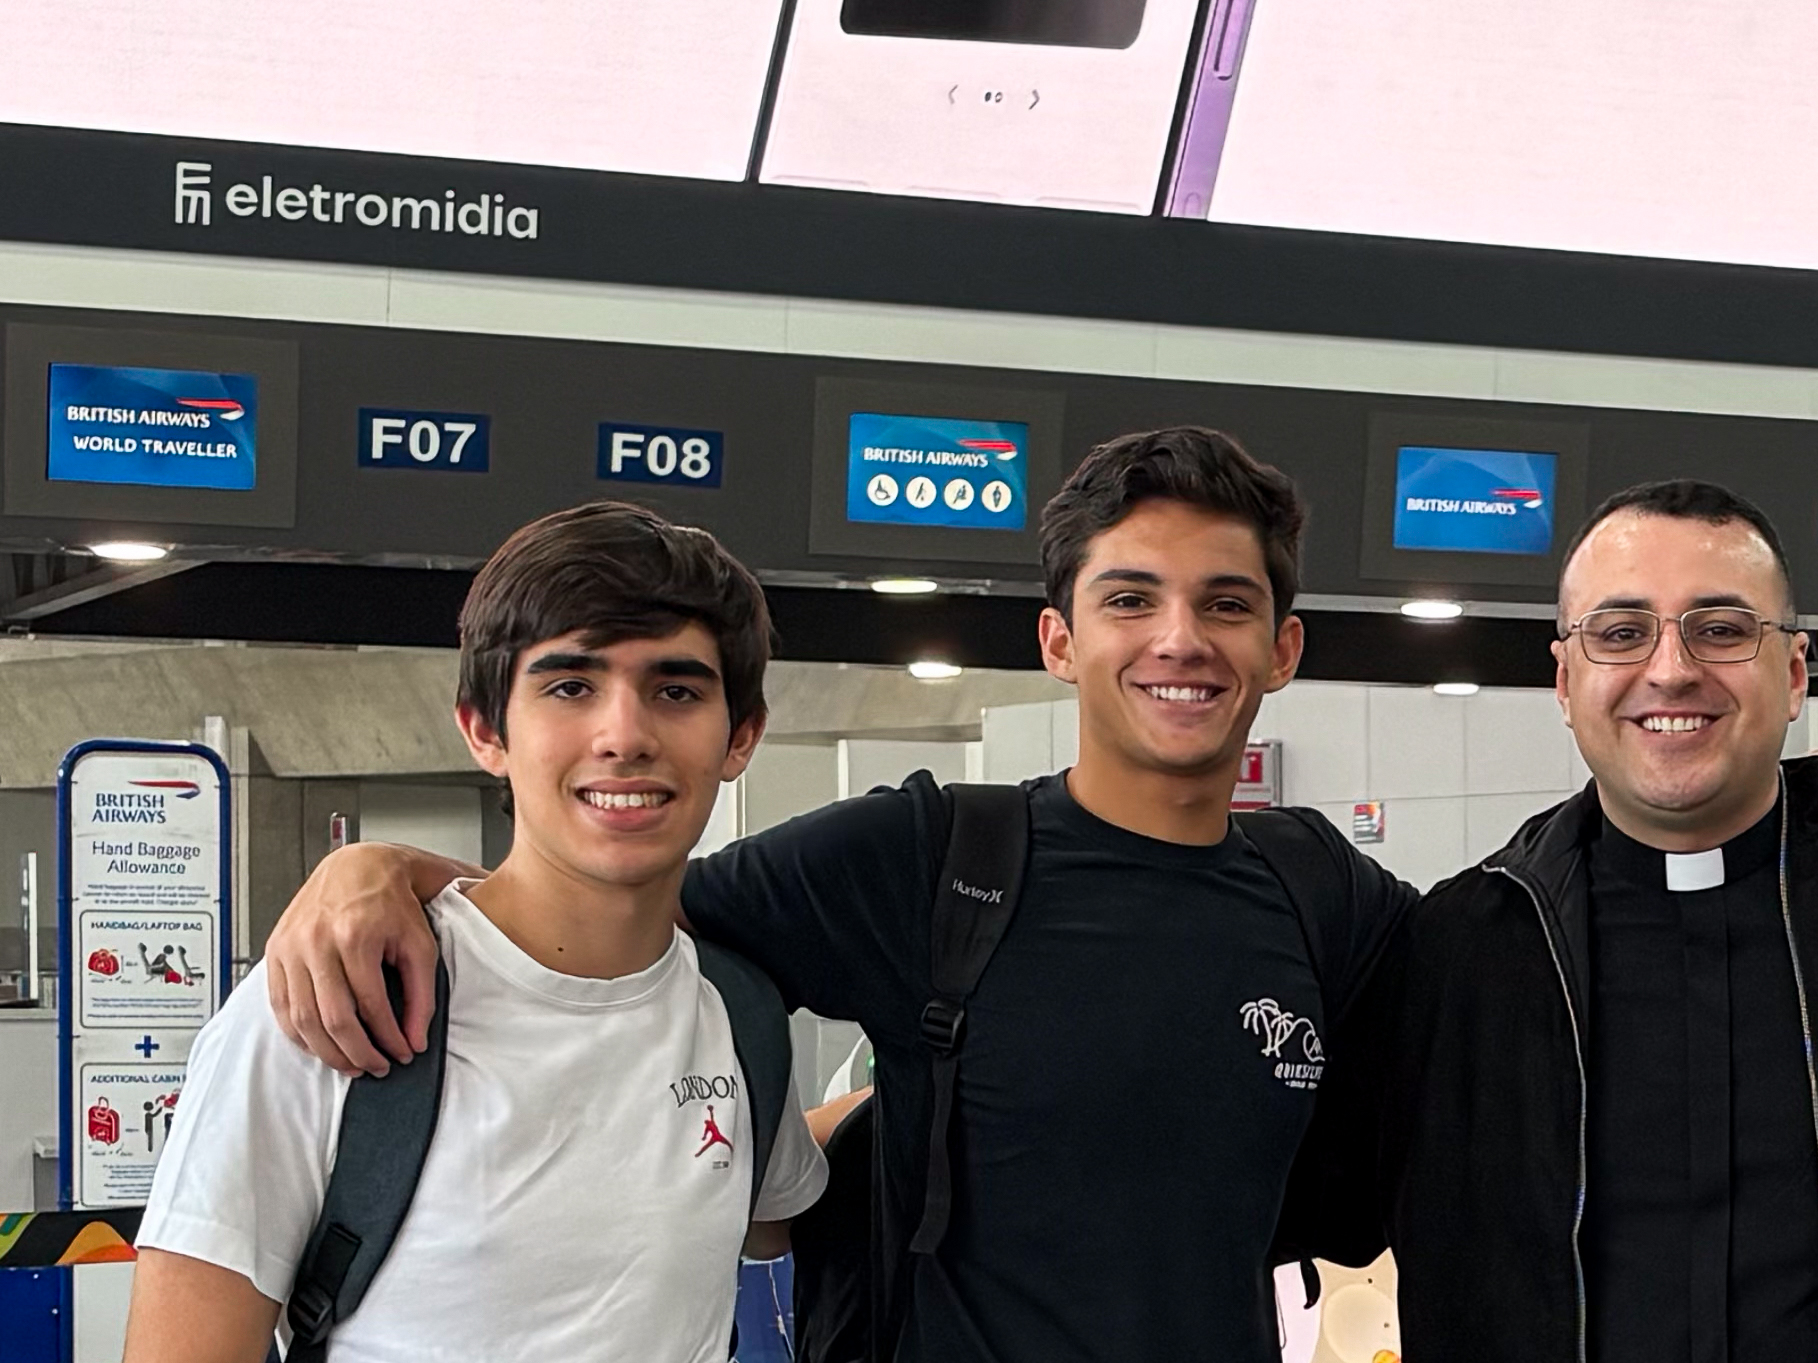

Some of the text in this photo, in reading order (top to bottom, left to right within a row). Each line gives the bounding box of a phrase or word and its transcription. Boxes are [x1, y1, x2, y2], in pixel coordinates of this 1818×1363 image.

[225, 175, 539, 239] eletromidia
[67, 405, 211, 429] BRITISH AIRWAYS
[73, 435, 238, 459] WORLD TRAVELLER
[371, 418, 477, 463] F07
[610, 432, 712, 479] F08
[863, 447, 989, 468] BRITISH AIRWAYS
[1406, 497, 1517, 516] BRITISH AIRWAYS
[95, 793, 165, 808] BRITISH
[92, 808, 167, 824] AIRWAYS
[92, 841, 201, 860] Hand Baggage
[107, 860, 186, 875] Allowance
